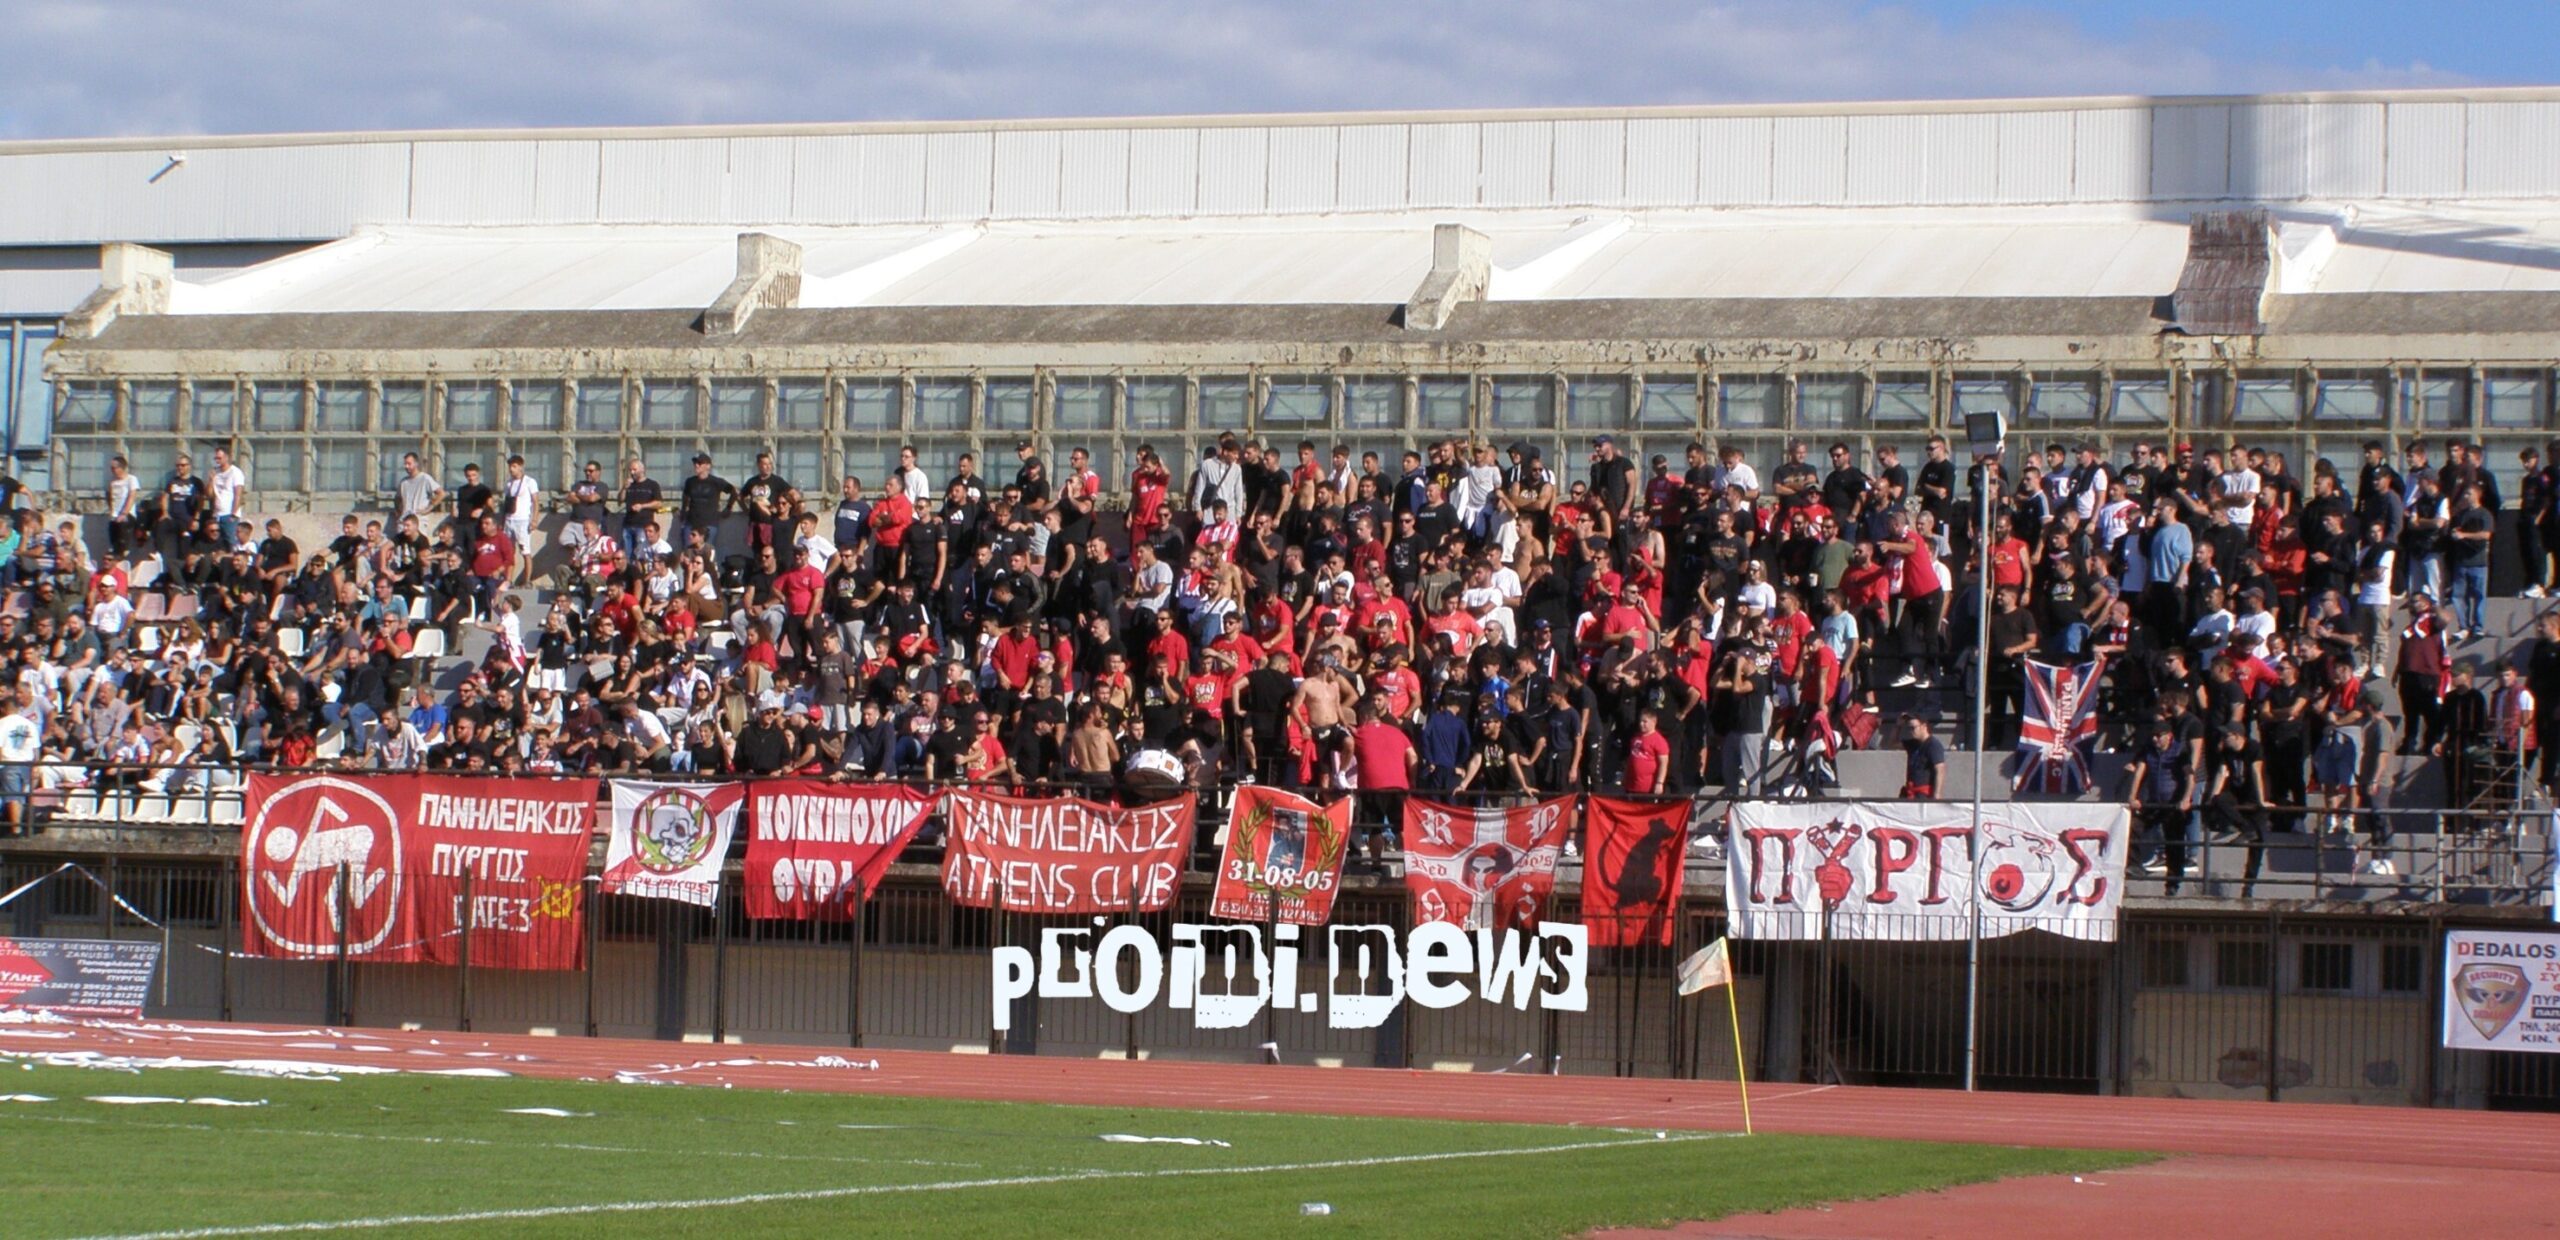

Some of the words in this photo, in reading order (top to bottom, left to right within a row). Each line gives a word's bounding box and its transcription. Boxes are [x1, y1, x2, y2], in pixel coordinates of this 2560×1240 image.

[418, 793, 589, 834] ΠΑΝΗΛΕΙΑΚΟΣ
[949, 793, 1184, 853] ΠΑΝΗΛΕΙΑΚΟΣ
[432, 843, 529, 883] ΠΥΡΓΟΣ
[946, 853, 1077, 907] ATHENS
[1092, 862, 1177, 907] CLUB
[1228, 859, 1334, 891] 31-08-05
[2457, 942, 2556, 959] DEDALOS
